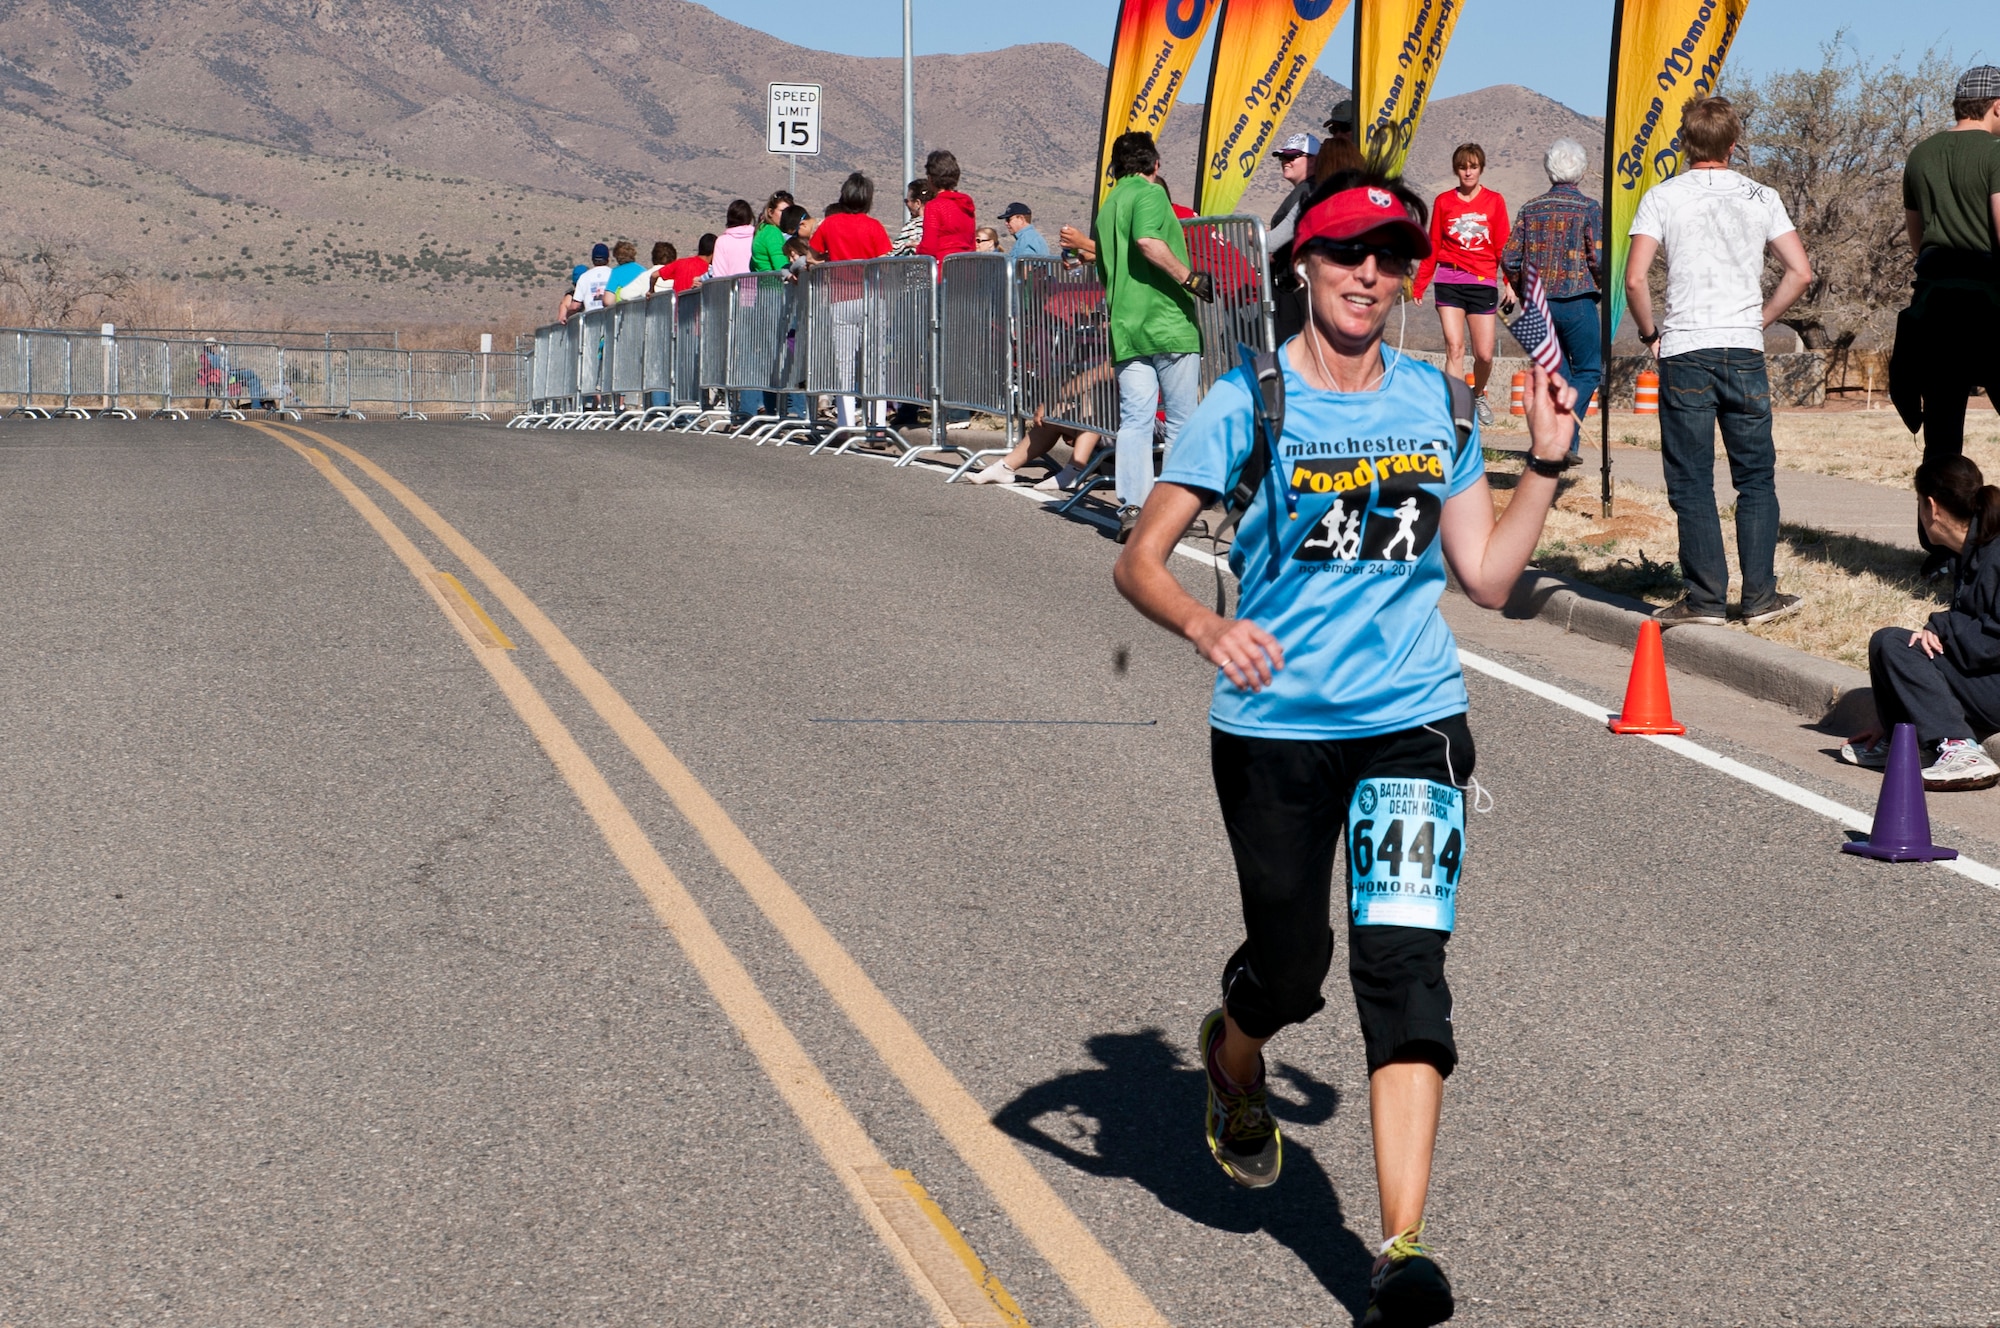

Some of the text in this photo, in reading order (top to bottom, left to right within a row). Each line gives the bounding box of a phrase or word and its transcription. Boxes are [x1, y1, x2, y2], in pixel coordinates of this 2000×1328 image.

[774, 91, 817, 102] SPEED
[1130, 40, 1174, 123] Memorial
[1148, 69, 1183, 126] March
[1211, 20, 1299, 180] Bataan Memorial
[778, 106, 811, 116] LIMIT
[1239, 54, 1307, 178] Death March
[1400, 80, 1426, 150] Death
[778, 121, 809, 146] 15
[1617, 96, 1663, 190] Bataan
[1285, 437, 1418, 457] manchester
[1380, 783, 1455, 807] BATAAN MEMORIAL
[1389, 800, 1448, 820] DEATH MARCH
[1353, 819, 1462, 885] 6444
[1358, 880, 1451, 898] HONORARY
